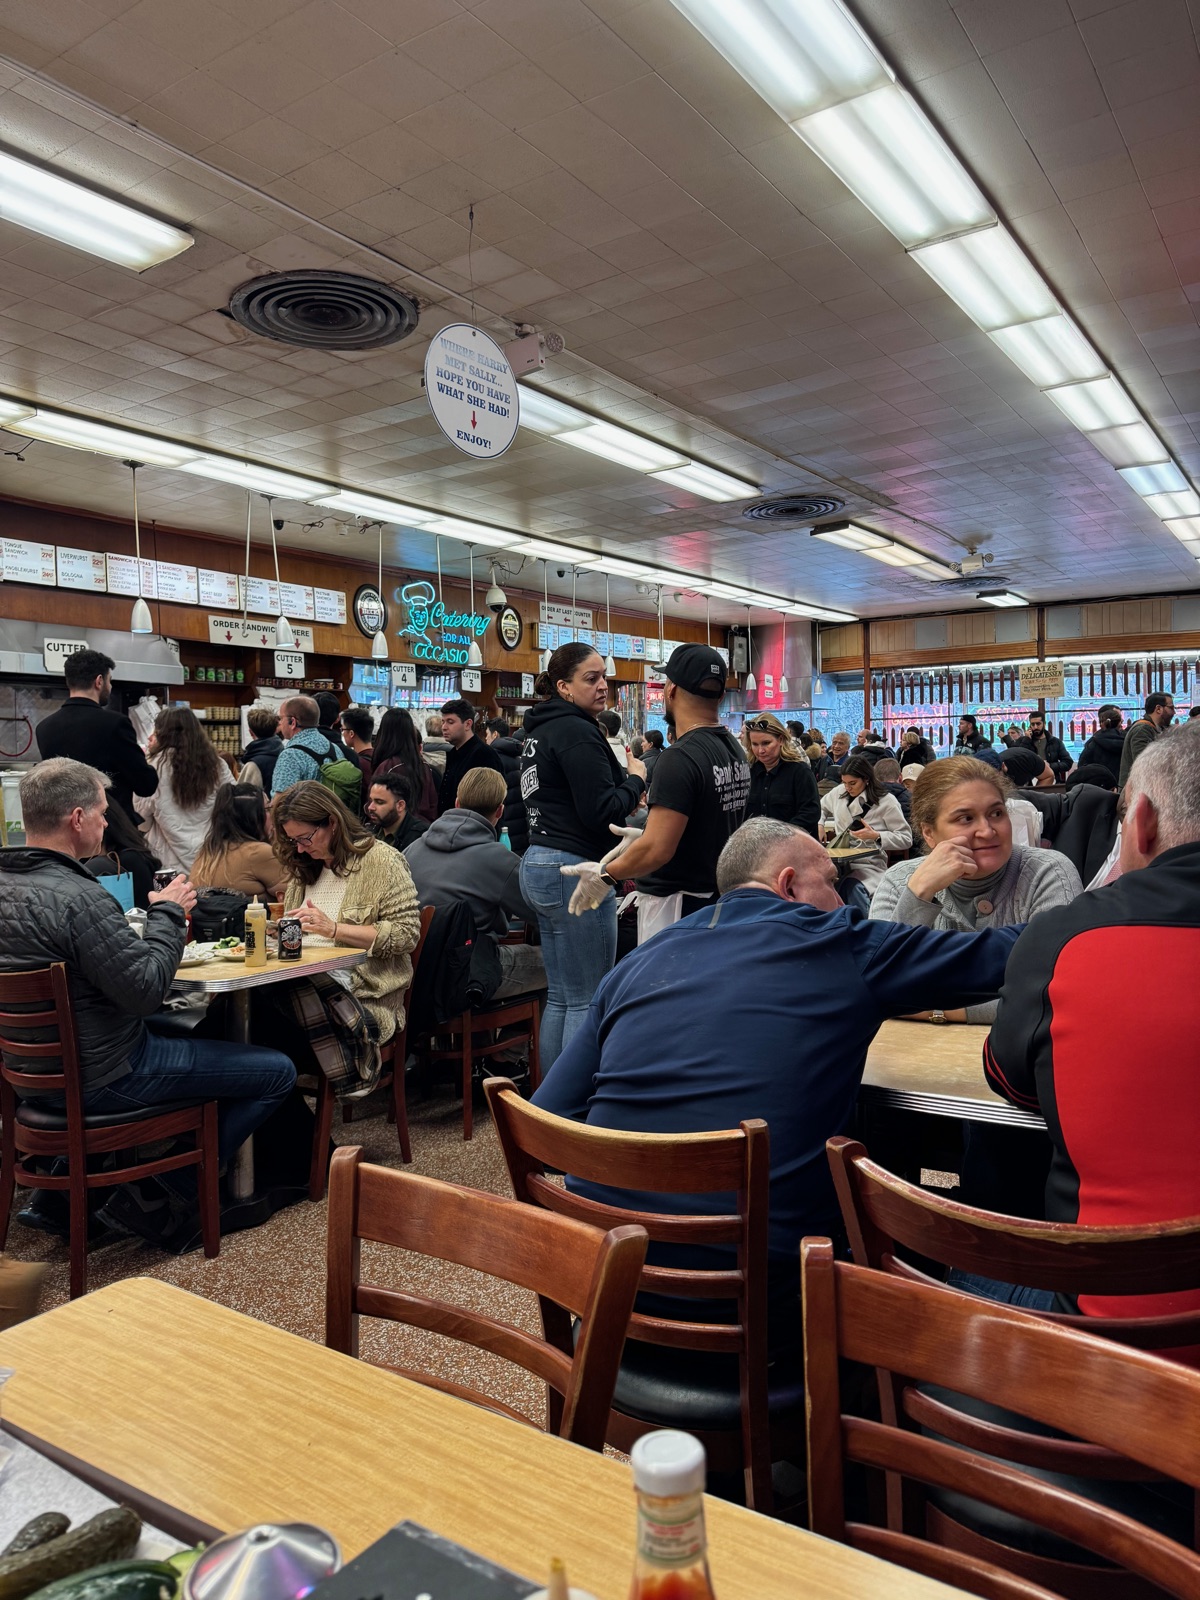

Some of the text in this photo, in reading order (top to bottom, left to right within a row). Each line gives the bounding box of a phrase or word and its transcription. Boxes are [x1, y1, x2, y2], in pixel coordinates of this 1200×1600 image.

[440, 337, 508, 375] WHERE HARRY
[445, 354, 466, 372] MET
[436, 366, 511, 404] HOPE YOU HAVE
[437, 381, 510, 418] WHAT SHE HAD!
[456, 430, 491, 450] ENJOY!
[108, 555, 132, 563] SANDWICH
[431, 602, 492, 636] Catering
[213, 620, 240, 629] ORDER
[442, 633, 457, 643] FOR
[414, 642, 469, 664] OCCASIO
[276, 654, 303, 663] CUTTER
[287, 664, 293, 674] 5
[392, 665, 415, 673] CUTTER
[1027, 663, 1058, 672] KATZ'S
[401, 673, 407, 683] 4
[1021, 670, 1063, 680] DELICATESSEN
[469, 679, 474, 689] 3
